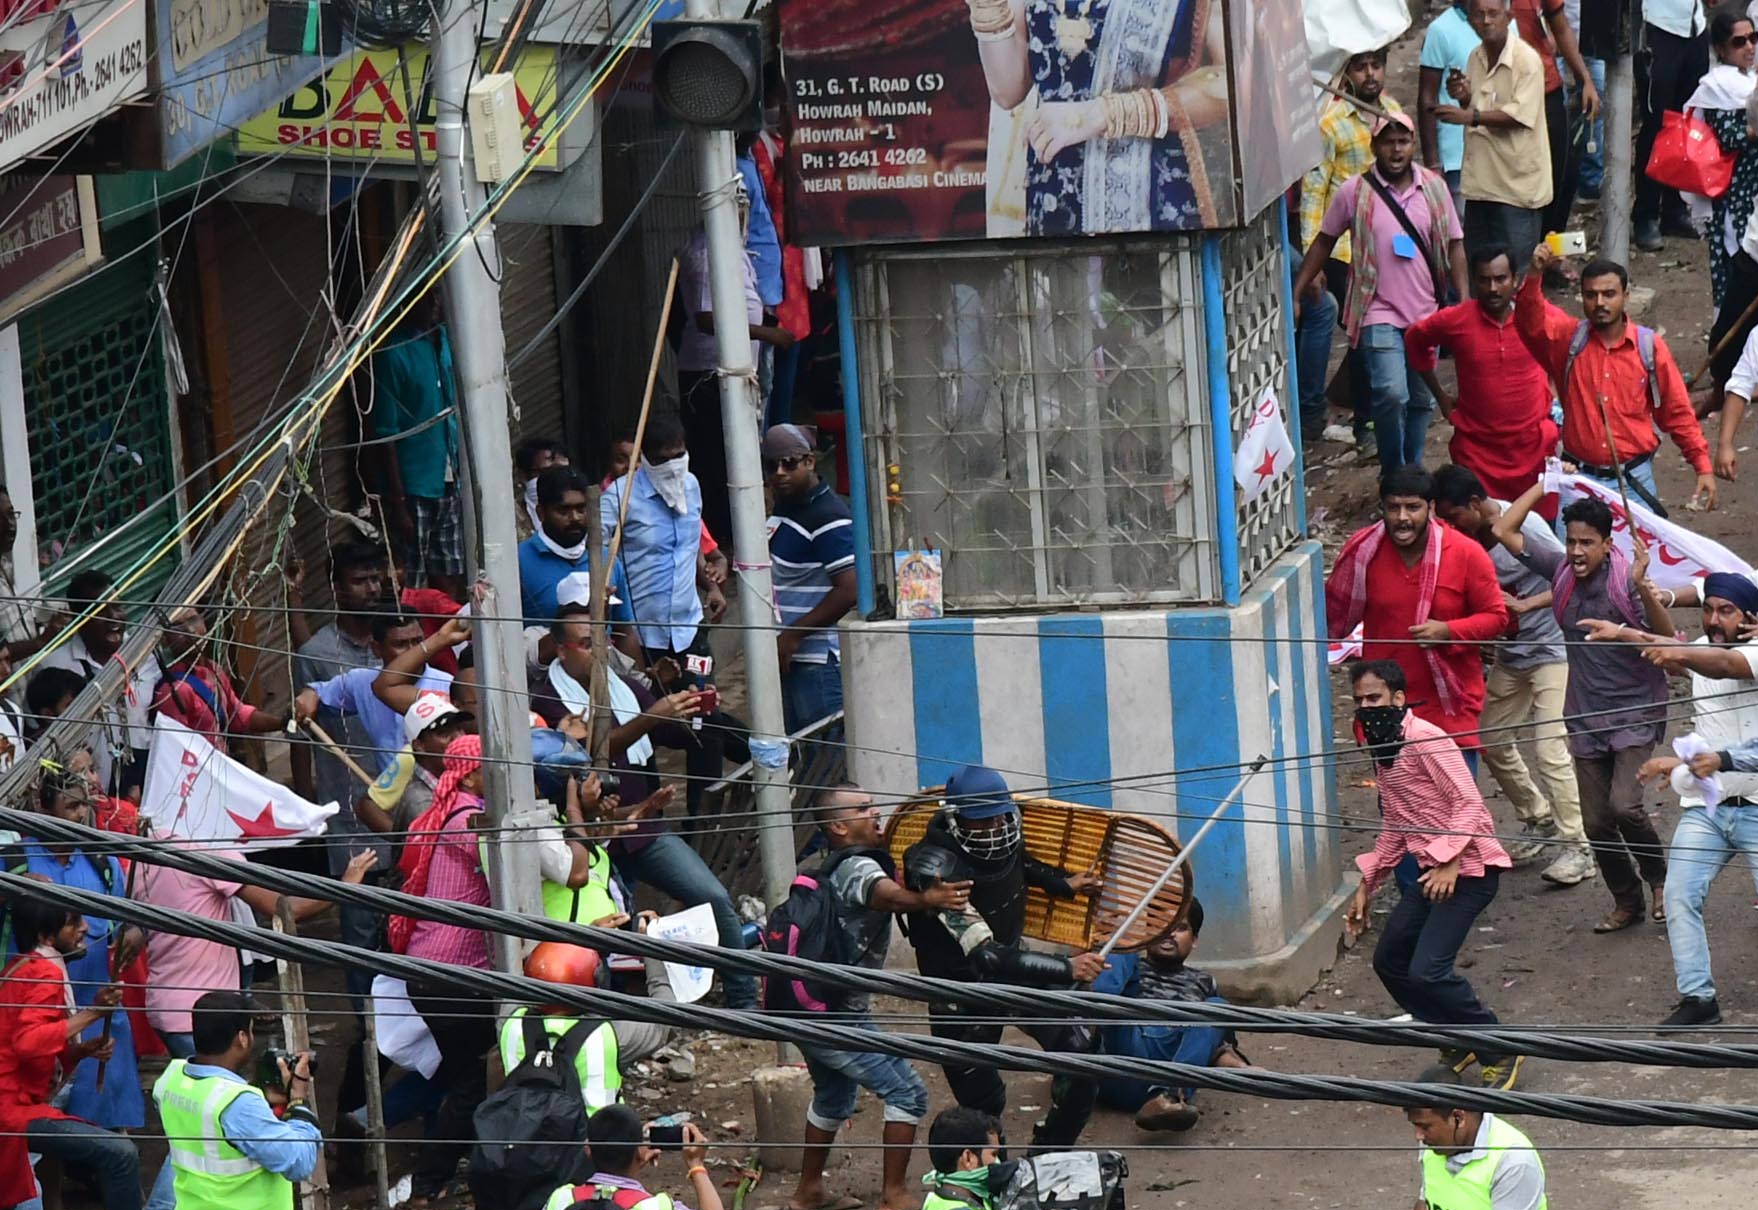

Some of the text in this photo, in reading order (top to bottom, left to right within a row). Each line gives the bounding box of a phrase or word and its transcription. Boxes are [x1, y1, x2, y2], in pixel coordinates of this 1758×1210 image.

[94, 52, 117, 92] 2641
[119, 39, 142, 77] 4262
[796, 73, 944, 97] 31, G. T. ROAD (S)
[798, 101, 932, 120] HOWRAH MAIDAN,
[277, 125, 382, 150] SHOE
[799, 126, 864, 144] HOWRAH
[885, 123, 896, 140] 1
[838, 151, 880, 168] 2641
[884, 148, 927, 165] 4262
[804, 178, 842, 193] NEAR
[847, 174, 928, 191] BANGABASI
